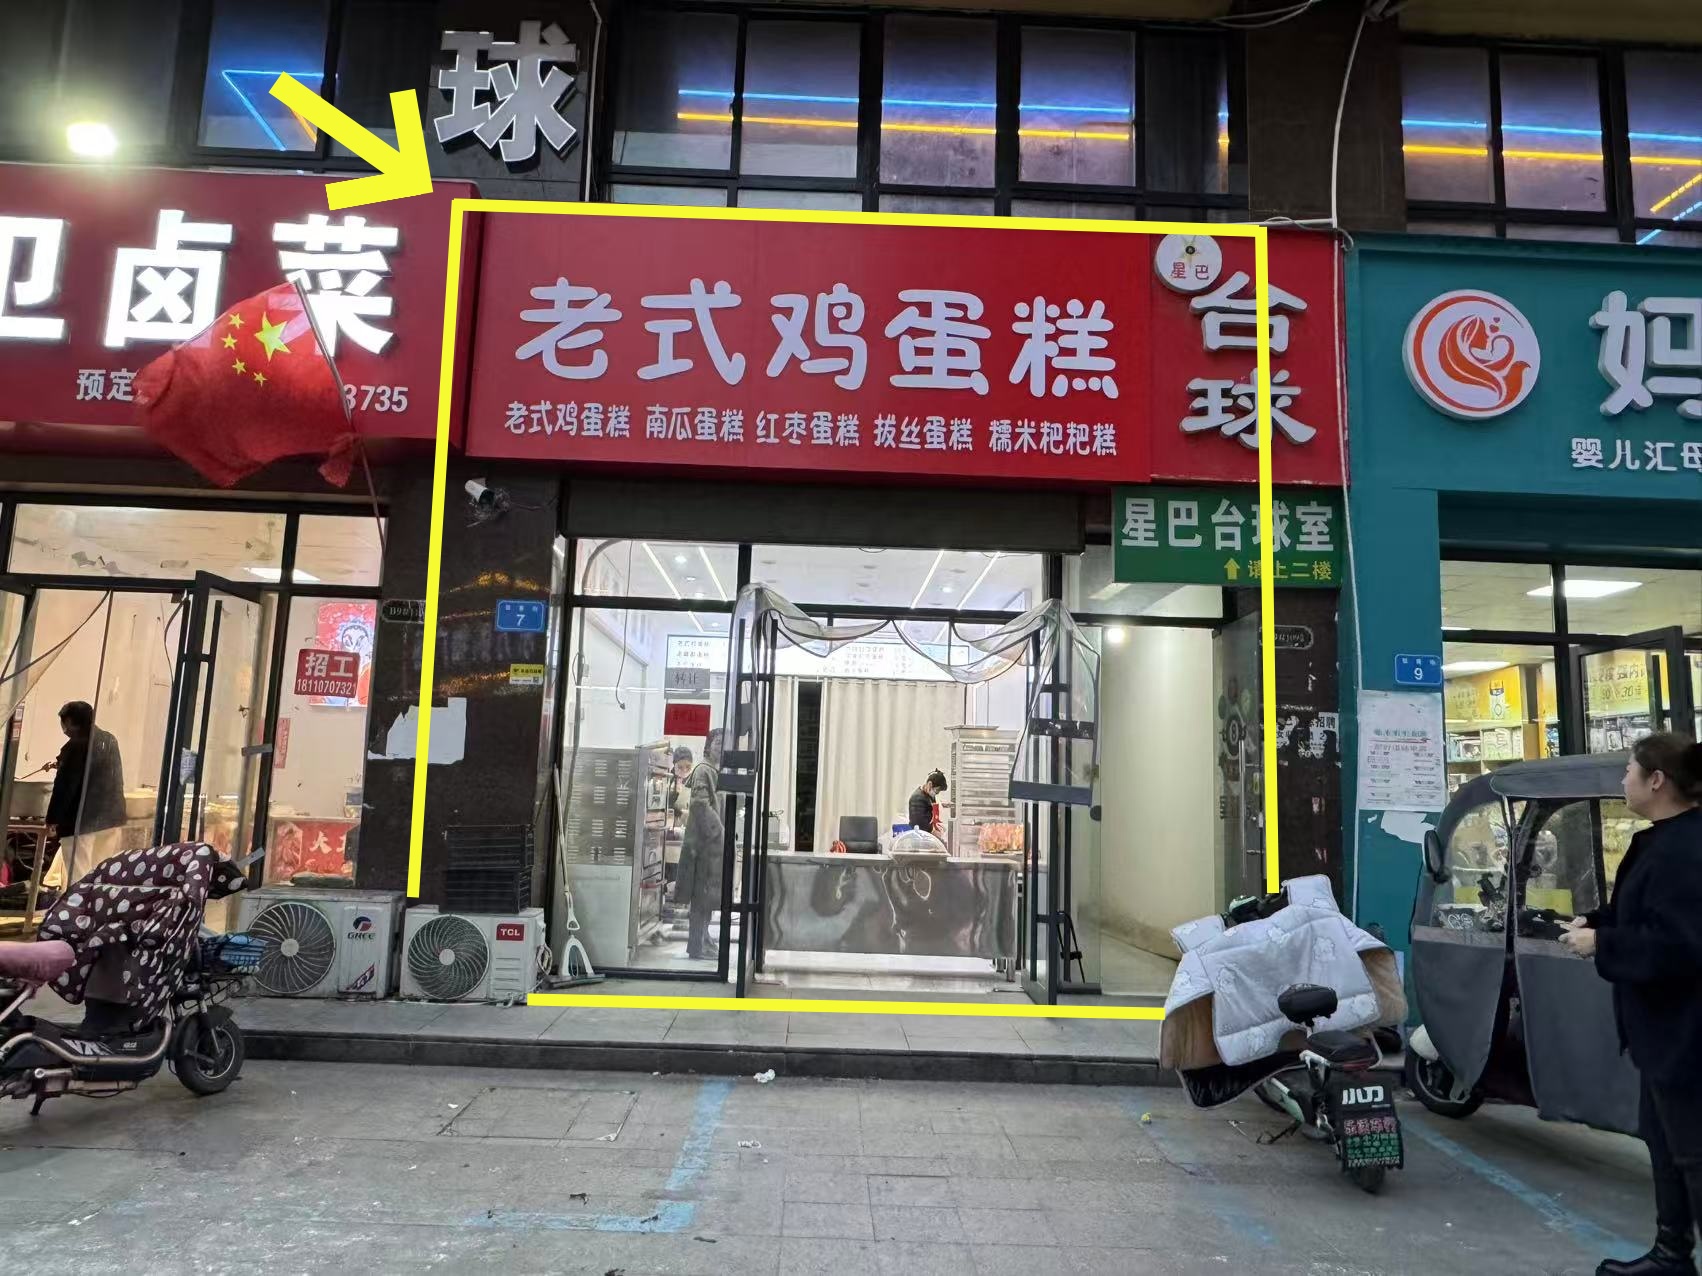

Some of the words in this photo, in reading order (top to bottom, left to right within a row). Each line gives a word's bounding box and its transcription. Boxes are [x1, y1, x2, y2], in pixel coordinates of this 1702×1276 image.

[434, 20, 576, 161] 球
[1171, 261, 1210, 280] 星巴
[515, 277, 1119, 399] 老式鸡蛋糕
[1179, 270, 1318, 450] 台球
[504, 400, 630, 438] 老式鸡蛋糕
[645, 403, 744, 442] 南瓜蛋糕
[756, 409, 860, 447] 红枣蛋糕
[873, 411, 973, 451] 拔丝蛋糕
[988, 418, 1117, 456] 糯米粑粑糕
[1121, 497, 1334, 553] 星巴台球室
[516, 614, 526, 626] 7
[305, 652, 353, 677] 招工
[1414, 667, 1423, 680] 9
[501, 928, 520, 937] TCL
